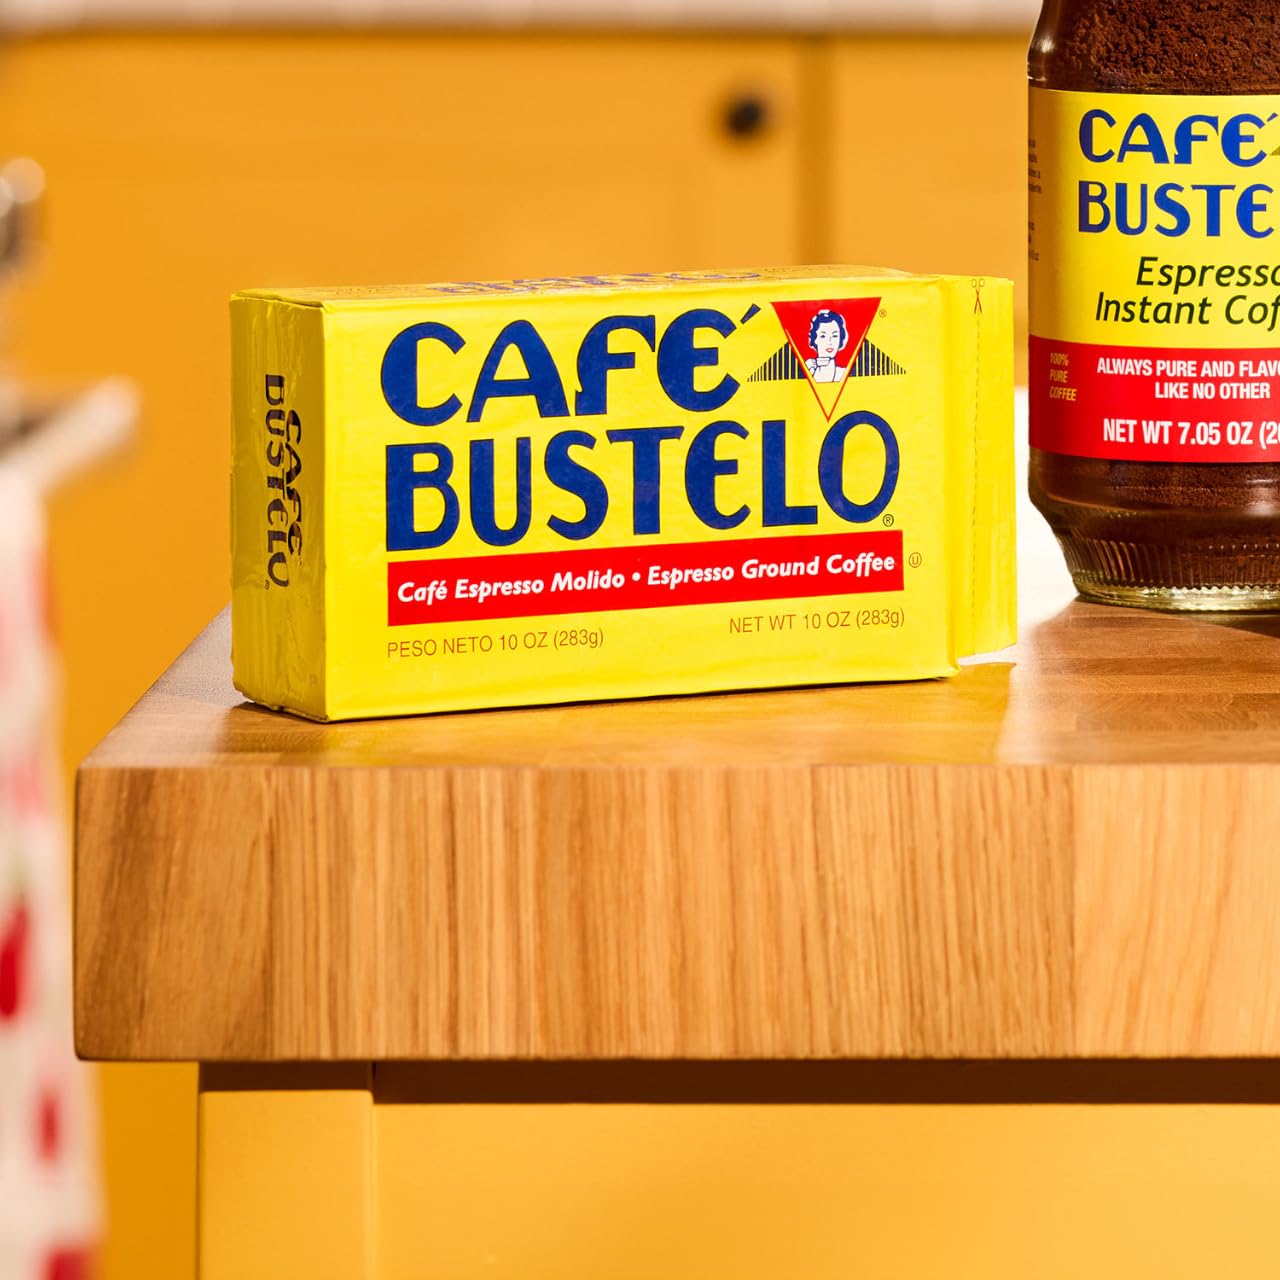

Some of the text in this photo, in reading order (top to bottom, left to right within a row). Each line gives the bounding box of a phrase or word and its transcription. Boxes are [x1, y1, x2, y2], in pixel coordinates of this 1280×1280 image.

[1078, 109, 1279, 168] CAFÉ
[1096, 292, 1211, 325] Instant
[381, 303, 761, 426] CAFÉ
[1050, 352, 1069, 367] 100%
[1096, 357, 1153, 377] ALWAYS
[1155, 360, 1197, 377] PURE
[1200, 360, 1235, 377] AND
[1049, 369, 1068, 383] PURE
[1049, 386, 1077, 401] COFFEE
[1155, 382, 1271, 400] LIKE NO OTHER
[1103, 418, 1137, 443] NET
[1141, 420, 1173, 445] WT
[1177, 421, 1221, 445] 7.05
[1226, 421, 1254, 445] OZ
[386, 410, 900, 552] BUSTELO
[397, 552, 895, 606] Café Espresso Molido Espresso Ground Coffee
[729, 608, 905, 634] NET WT 10 OZ (283g)
[387, 627, 604, 658] PESO NETO 10 OZ (283g)
